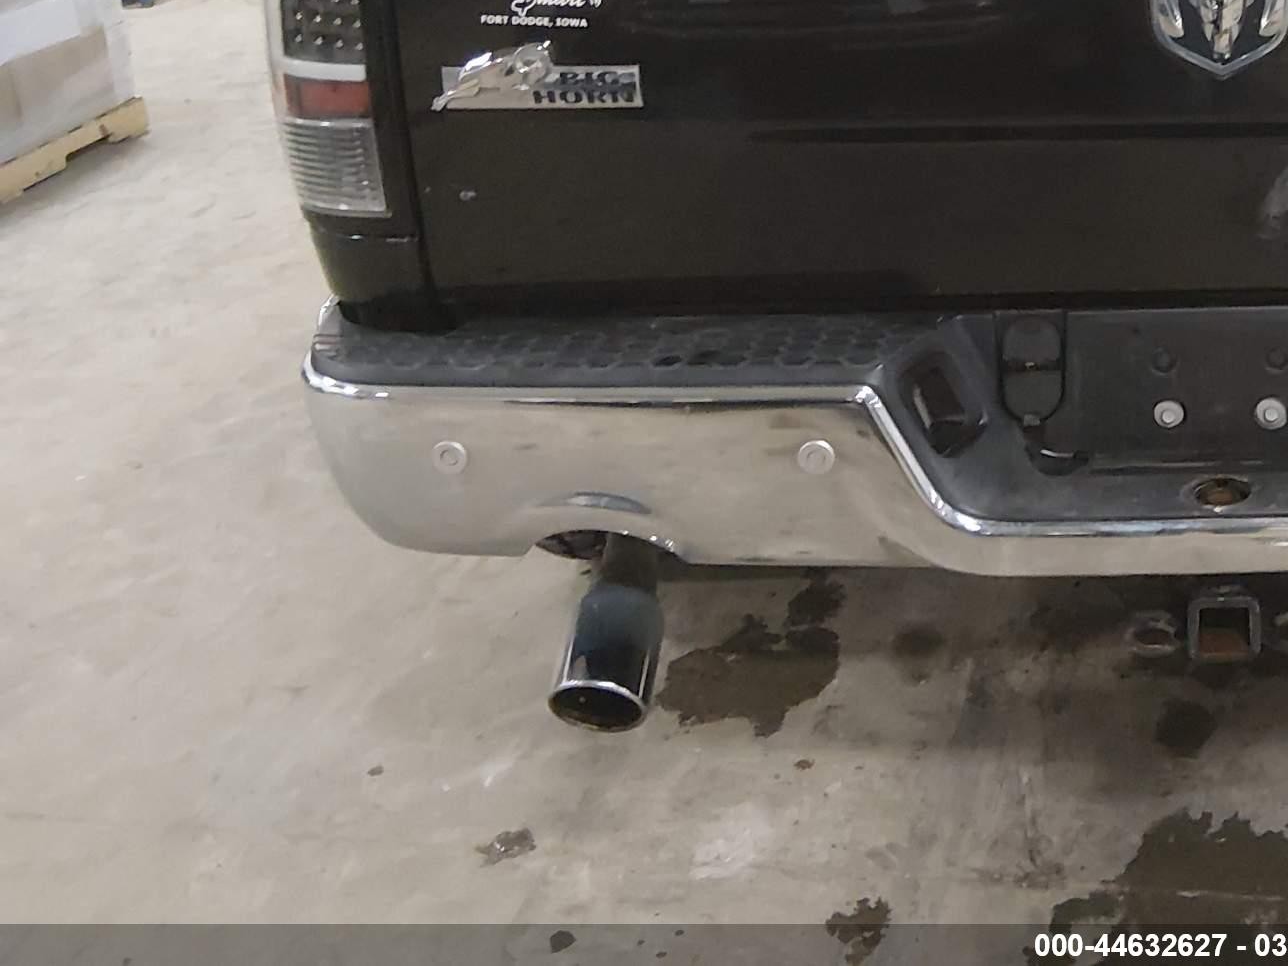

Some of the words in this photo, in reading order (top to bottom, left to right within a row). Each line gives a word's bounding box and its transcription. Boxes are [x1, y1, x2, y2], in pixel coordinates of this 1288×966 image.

[480, 14, 509, 25] FORT
[511, 15, 554, 28] DODGE,
[555, 17, 589, 28] IOWA
[559, 71, 620, 86] BIG
[532, 89, 636, 104] HORN
